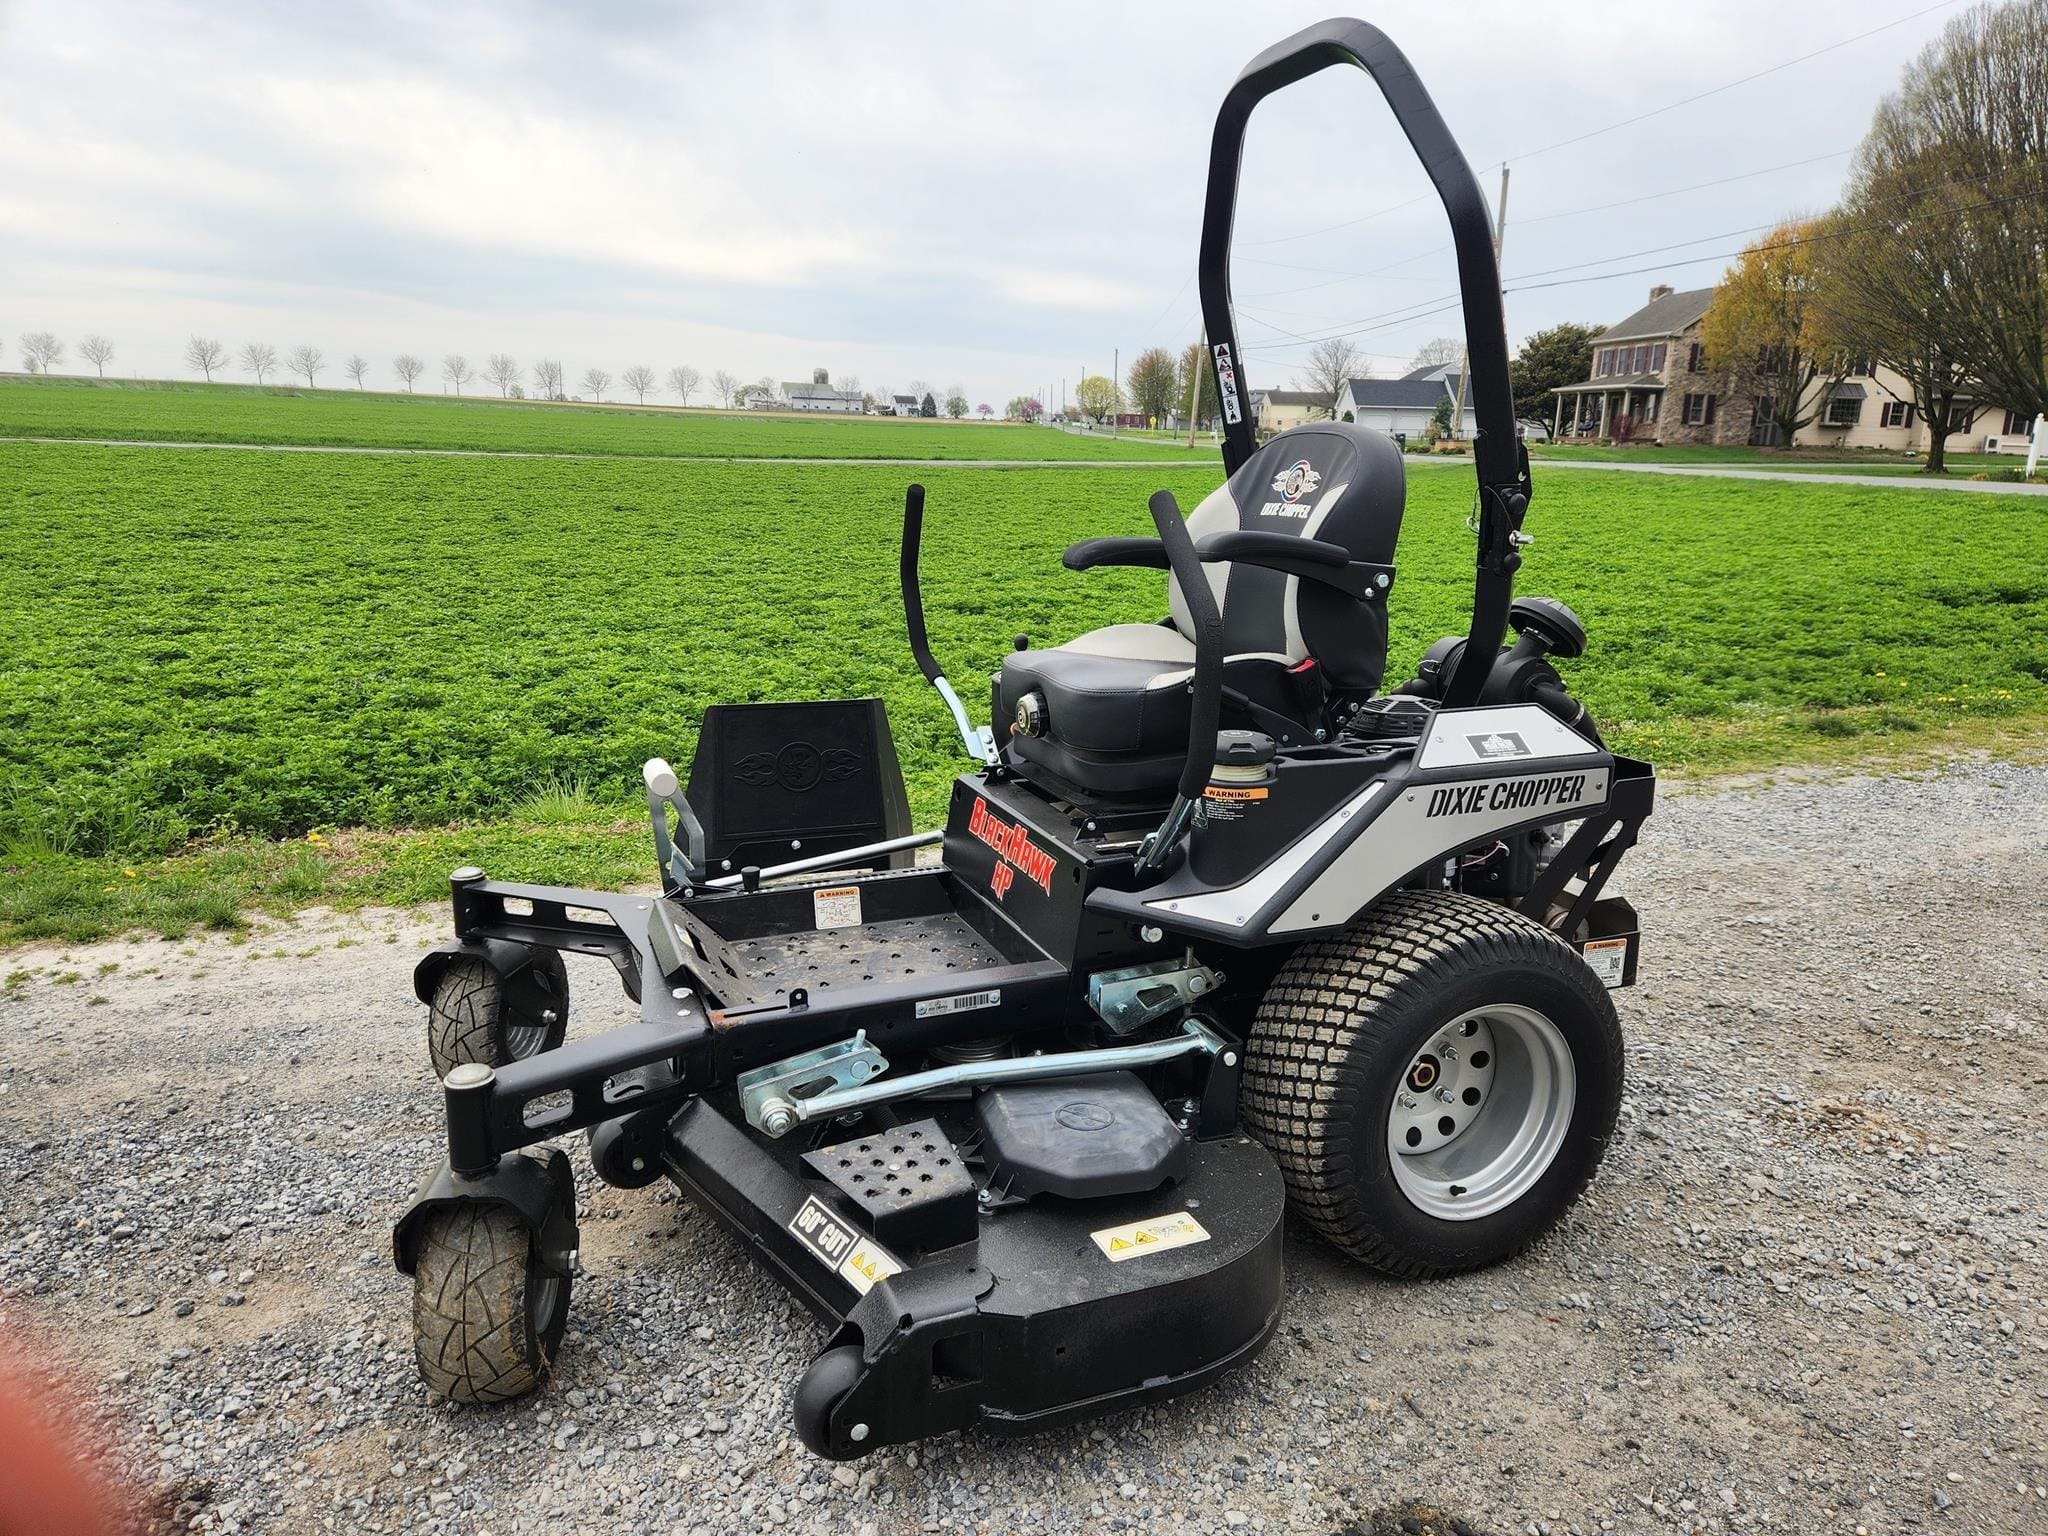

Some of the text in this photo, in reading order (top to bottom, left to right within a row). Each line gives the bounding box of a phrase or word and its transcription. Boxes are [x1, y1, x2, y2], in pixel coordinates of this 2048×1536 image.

[1208, 789, 1251, 799] WARNING
[1426, 775, 1585, 817] DIXIE CHOPPER
[826, 889, 855, 897] WARNING
[990, 859, 1014, 901] HP
[798, 1205, 850, 1258] 60" CUT
